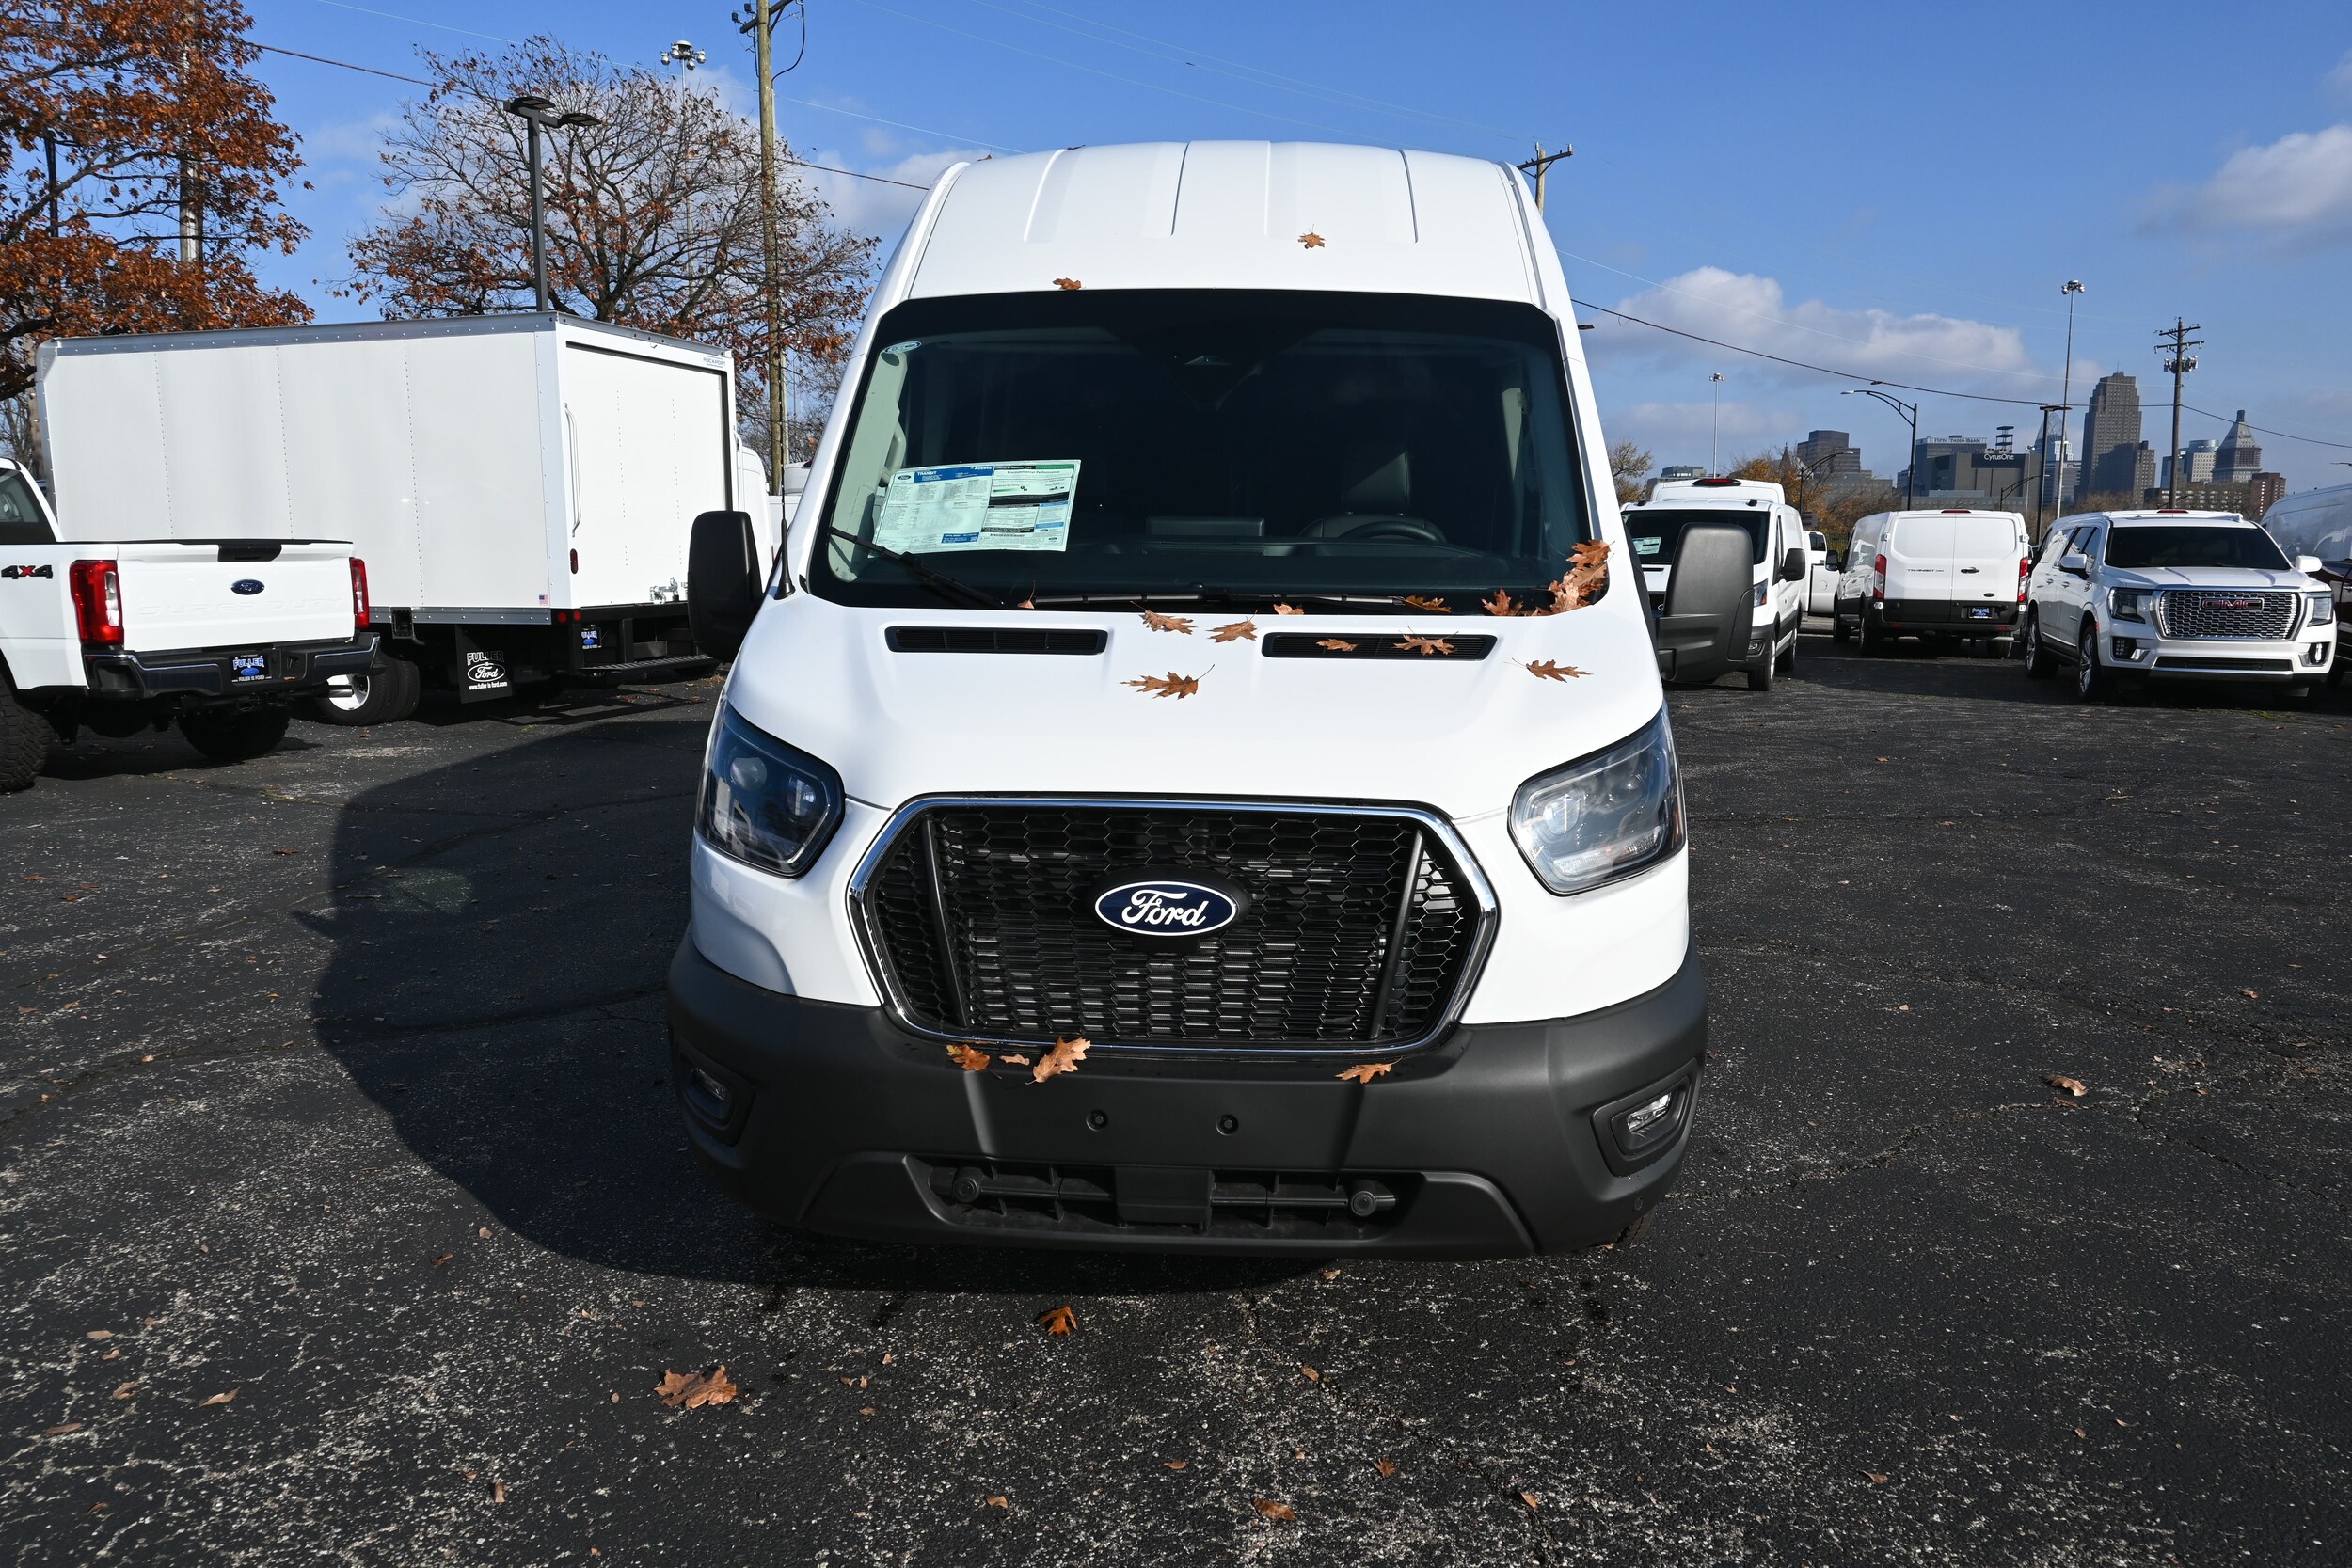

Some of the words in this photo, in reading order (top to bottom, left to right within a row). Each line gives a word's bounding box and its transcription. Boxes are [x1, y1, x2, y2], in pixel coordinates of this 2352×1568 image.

[140, 601, 259, 616] SUPER
[267, 597, 342, 610] DUTY
[2202, 599, 2262, 610] GMC
[232, 658, 264, 670] FULLER
[466, 651, 505, 666] FULLER
[475, 666, 498, 679] Ford
[1121, 889, 1210, 927] Ford
